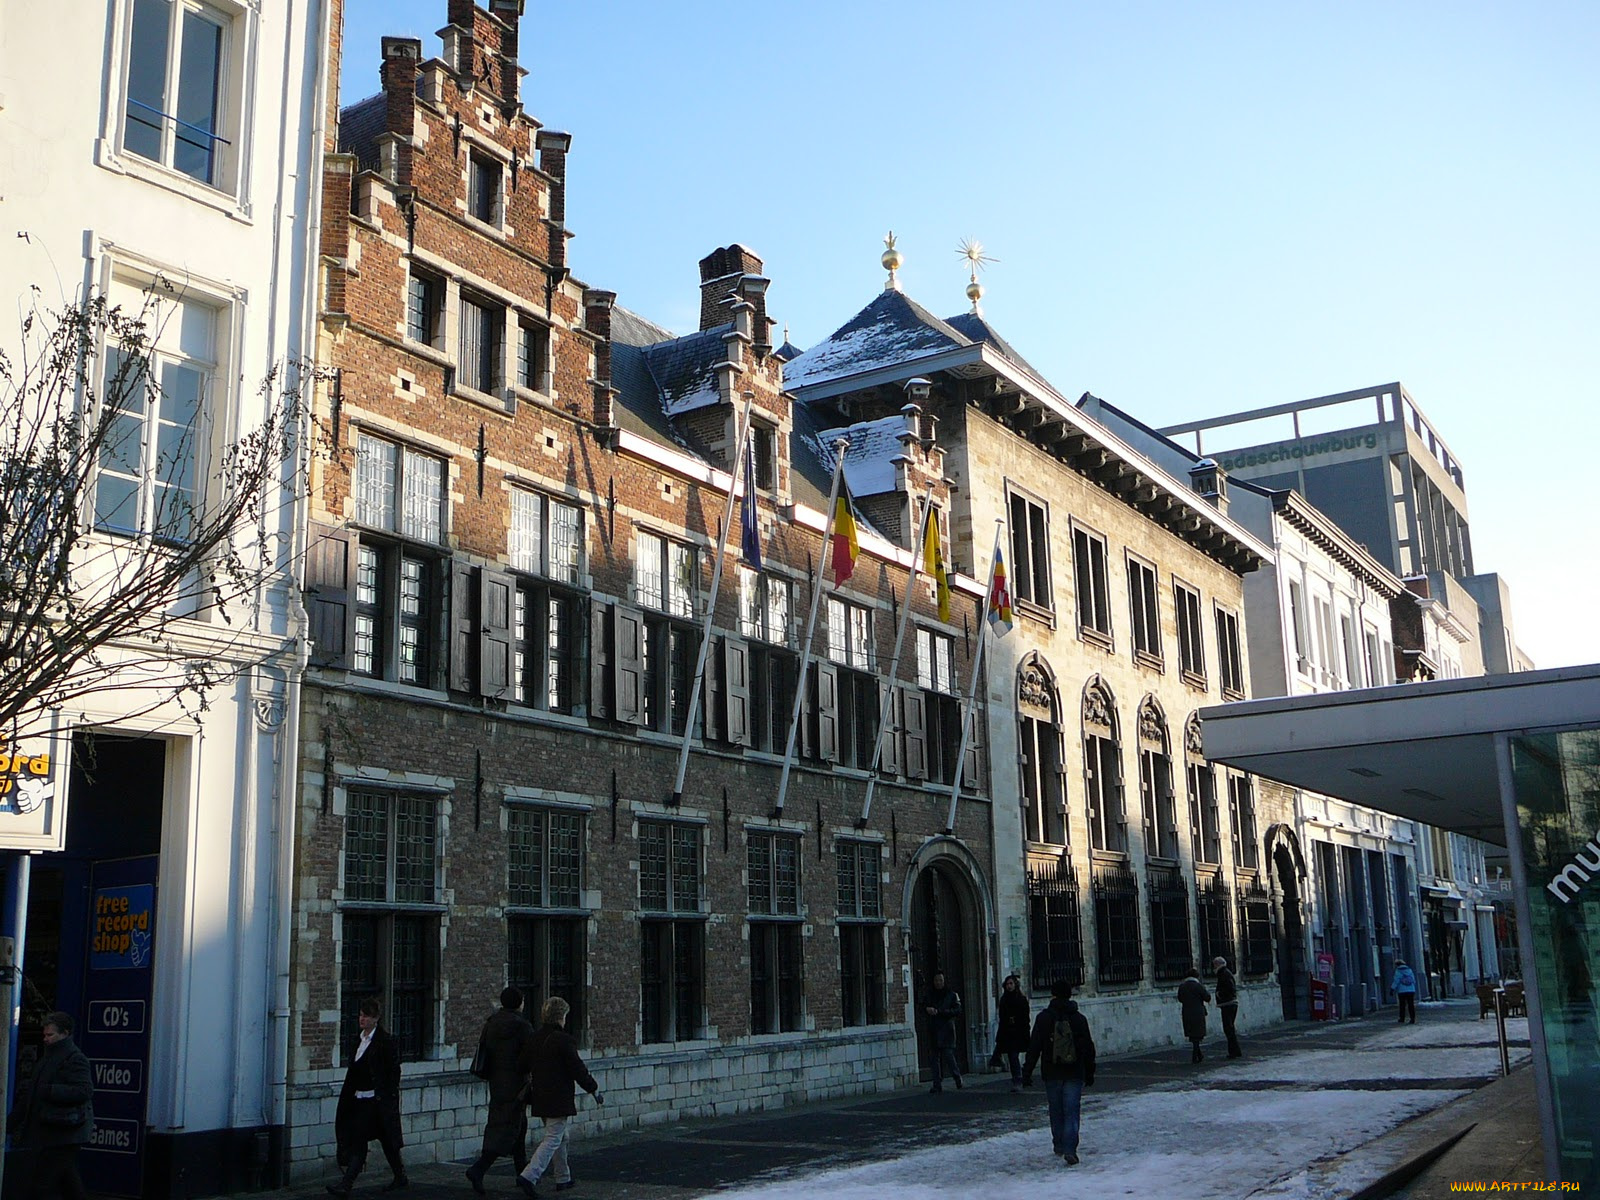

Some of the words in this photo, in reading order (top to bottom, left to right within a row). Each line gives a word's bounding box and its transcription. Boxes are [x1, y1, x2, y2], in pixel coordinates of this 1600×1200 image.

[1546, 829, 1600, 903] mu
[96, 895, 129, 914] free
[97, 909, 149, 932] record
[93, 931, 130, 954] shop
[103, 1006, 129, 1026] CD's
[95, 1063, 131, 1085] Video
